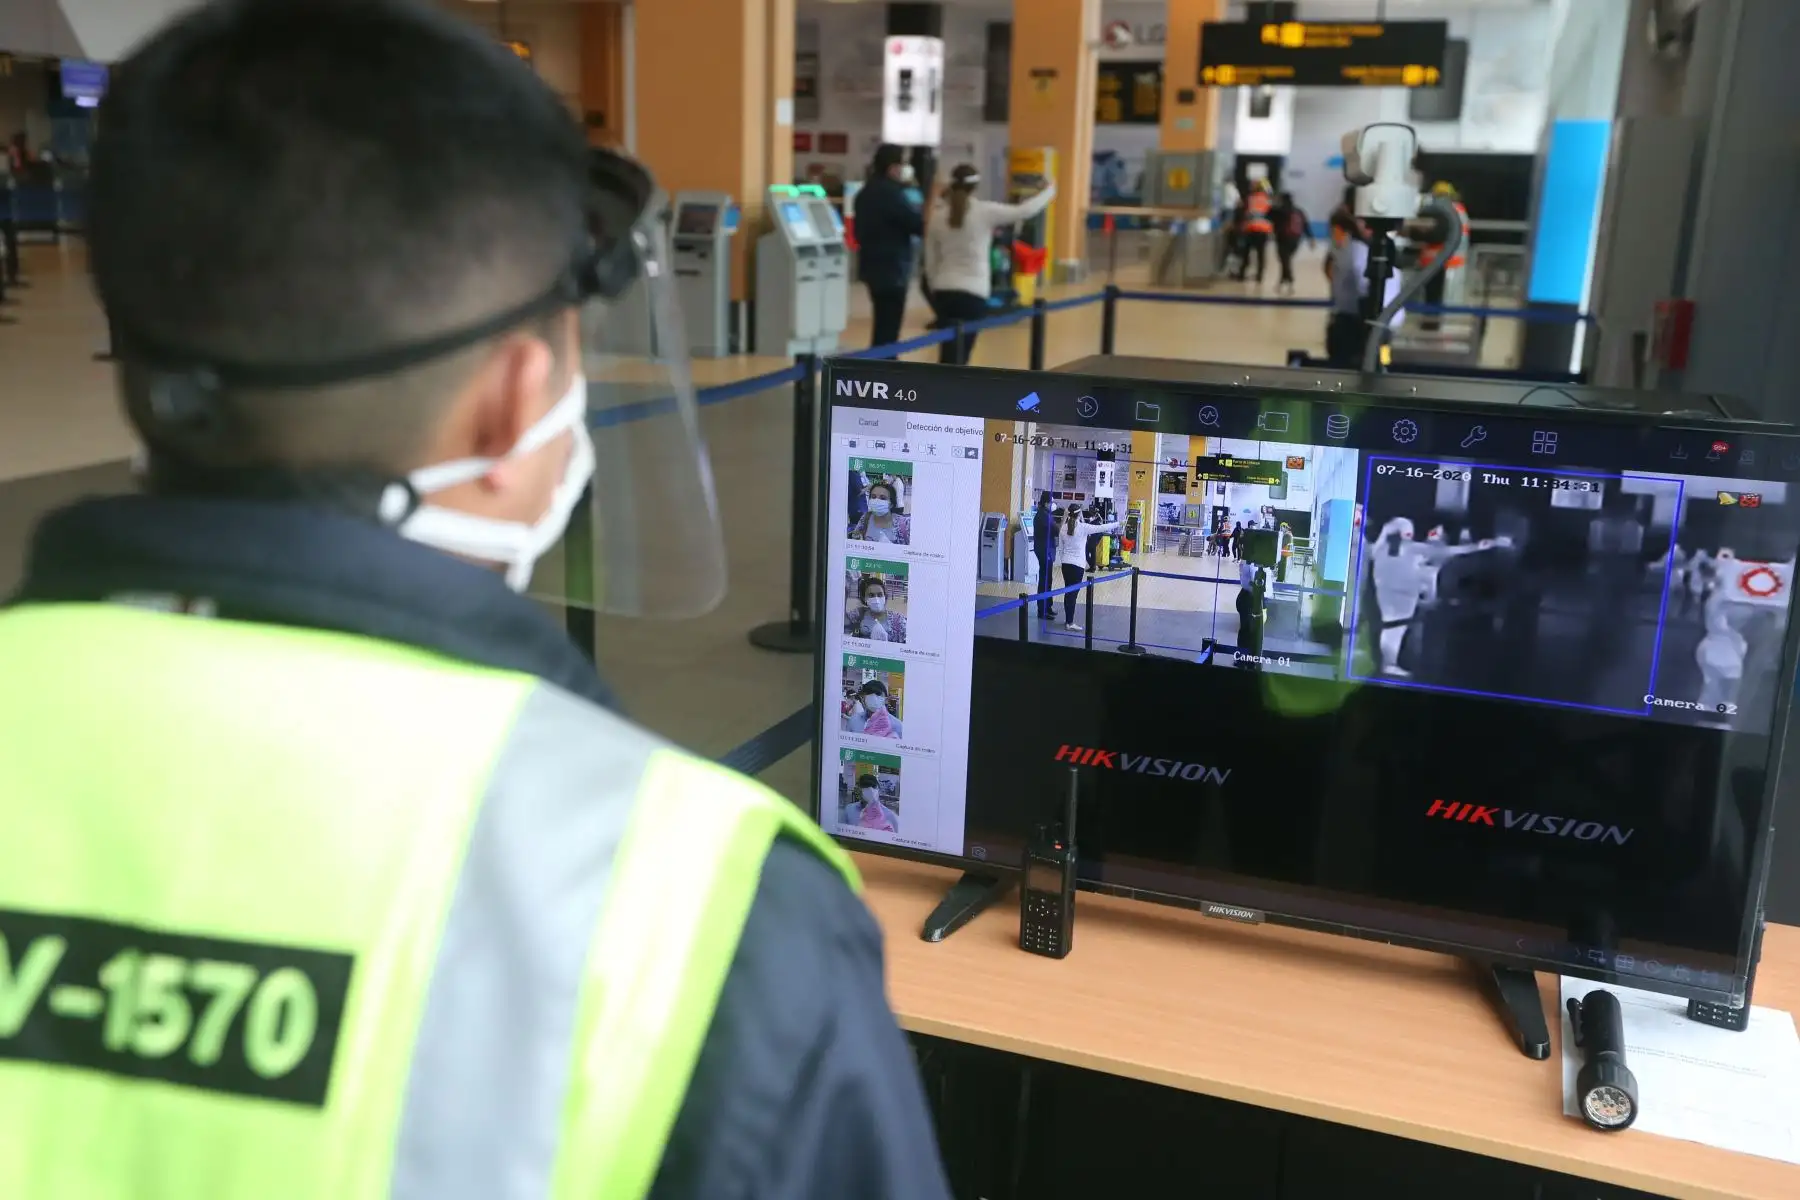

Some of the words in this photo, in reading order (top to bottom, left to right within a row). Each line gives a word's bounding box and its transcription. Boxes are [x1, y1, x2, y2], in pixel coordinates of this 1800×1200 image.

[835, 379, 889, 400] NVR
[894, 389, 917, 401] 4.0
[858, 417, 879, 427] Canal
[906, 421, 942, 433] Detección
[944, 425, 953, 433] de
[955, 426, 984, 437] objetivo
[994, 433, 1054, 447] 07-16-2020
[1060, 439, 1078, 449] Thu
[1084, 440, 1133, 454] 11:34:31
[1376, 464, 1472, 482] 07-16-2020
[1482, 473, 1510, 486] Thu
[1521, 476, 1601, 493] 11:34:31
[1233, 651, 1272, 666] Camera
[1278, 656, 1291, 667] 01
[1643, 694, 1705, 711] Camera
[1716, 702, 1738, 715] 02
[1054, 744, 1233, 787] HIKVISION
[1425, 799, 1634, 847] HIKVISION
[1208, 905, 1254, 919] HIKVISION
[0, 930, 320, 1080] V-1570
